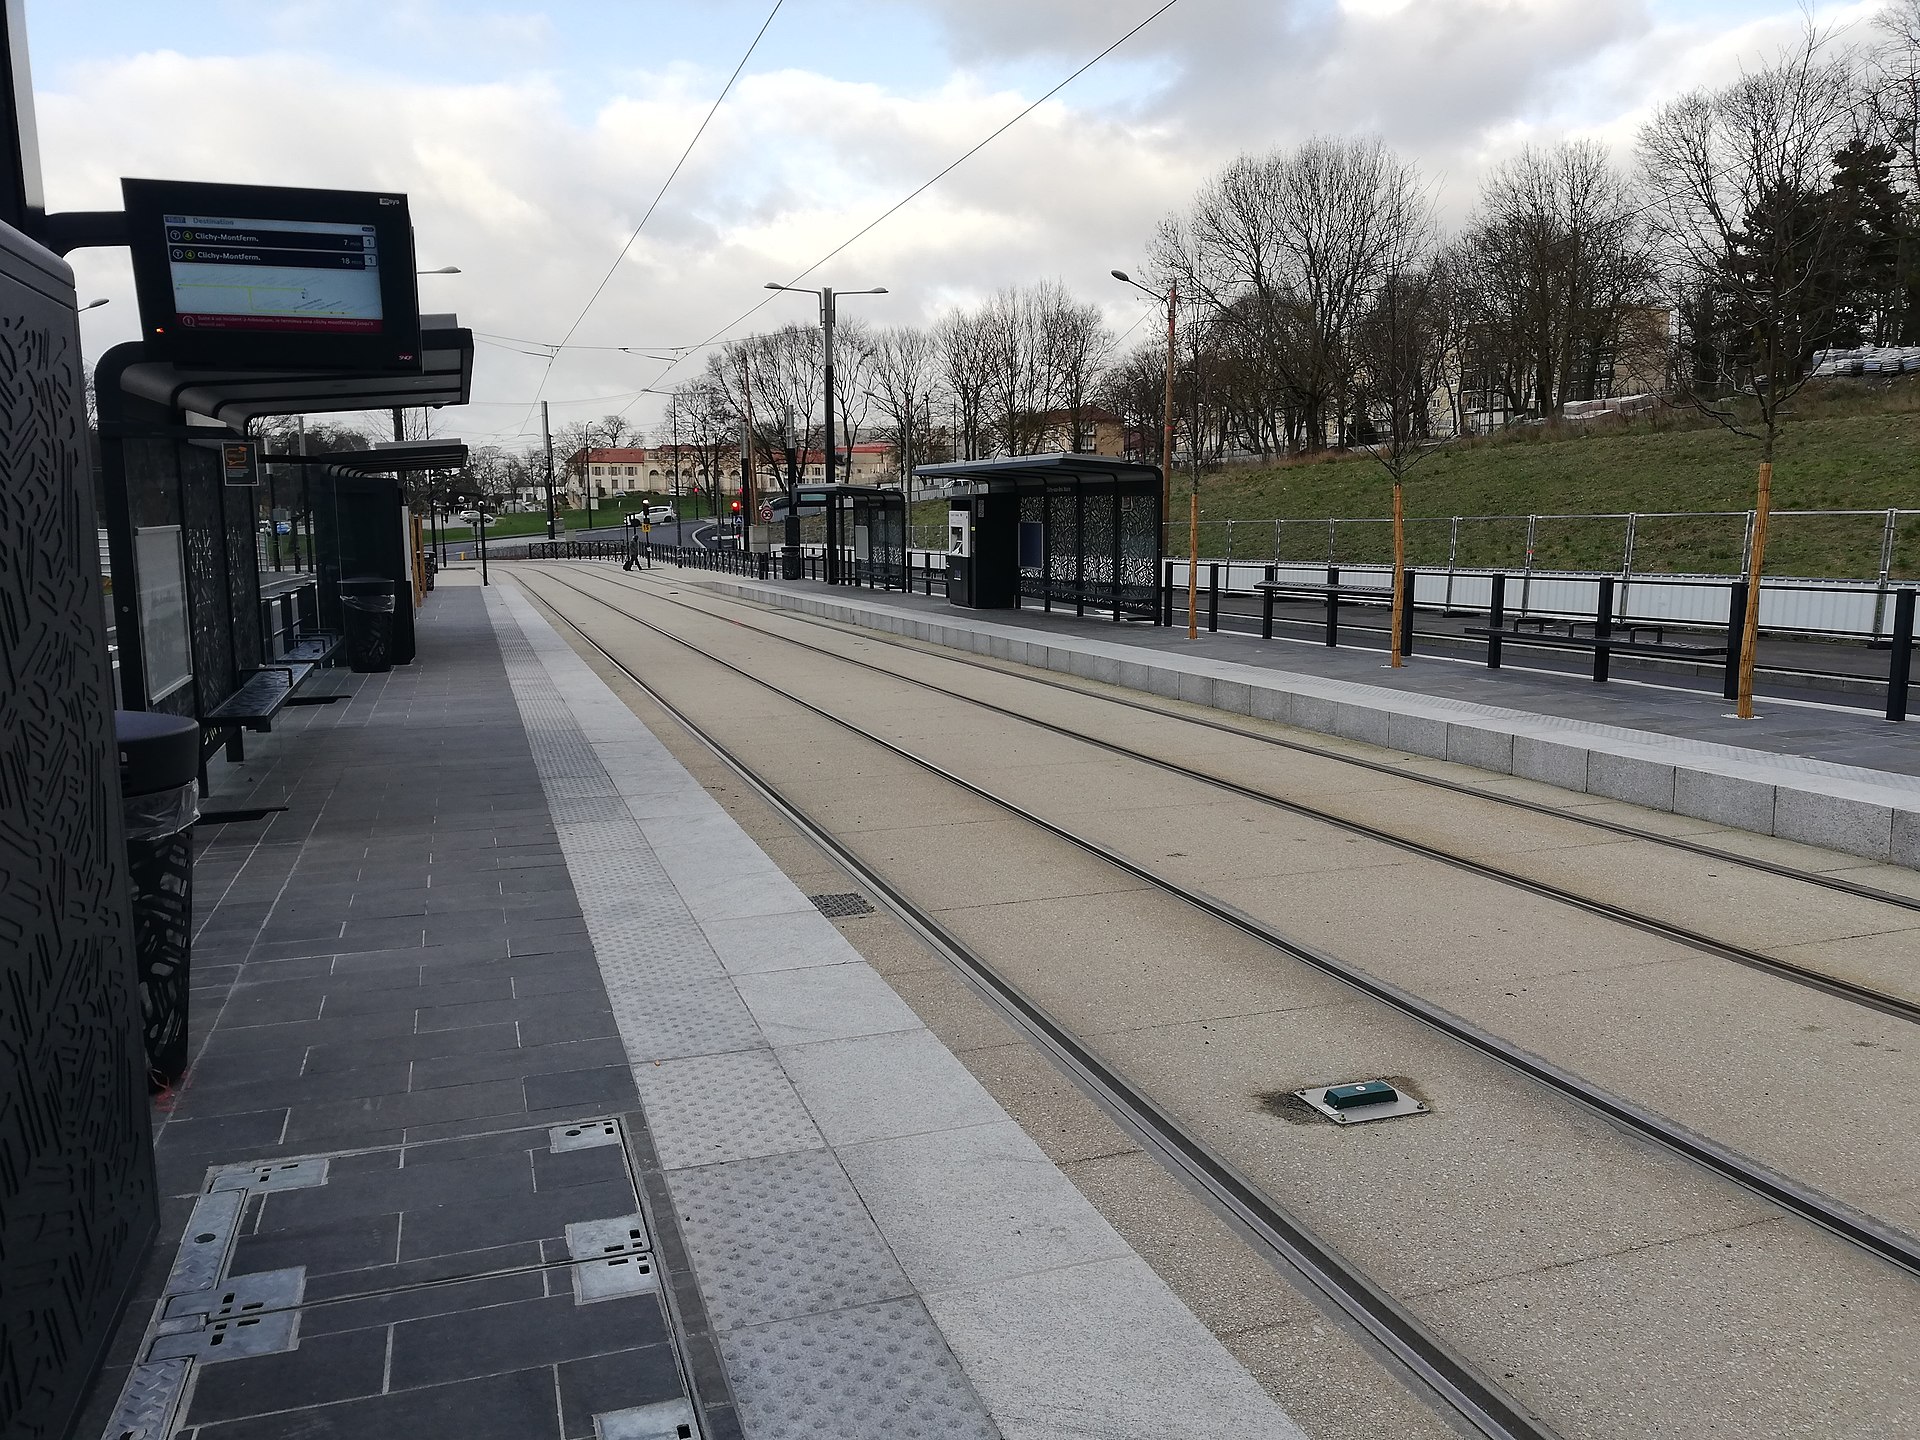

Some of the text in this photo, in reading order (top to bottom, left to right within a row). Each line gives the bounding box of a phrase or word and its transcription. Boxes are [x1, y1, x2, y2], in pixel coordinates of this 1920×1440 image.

[192, 217, 234, 225] Destination
[195, 231, 259, 242] Clichy-Montferm.
[197, 250, 261, 261] Clichy-Montferm.
[341, 257, 350, 265] 18
